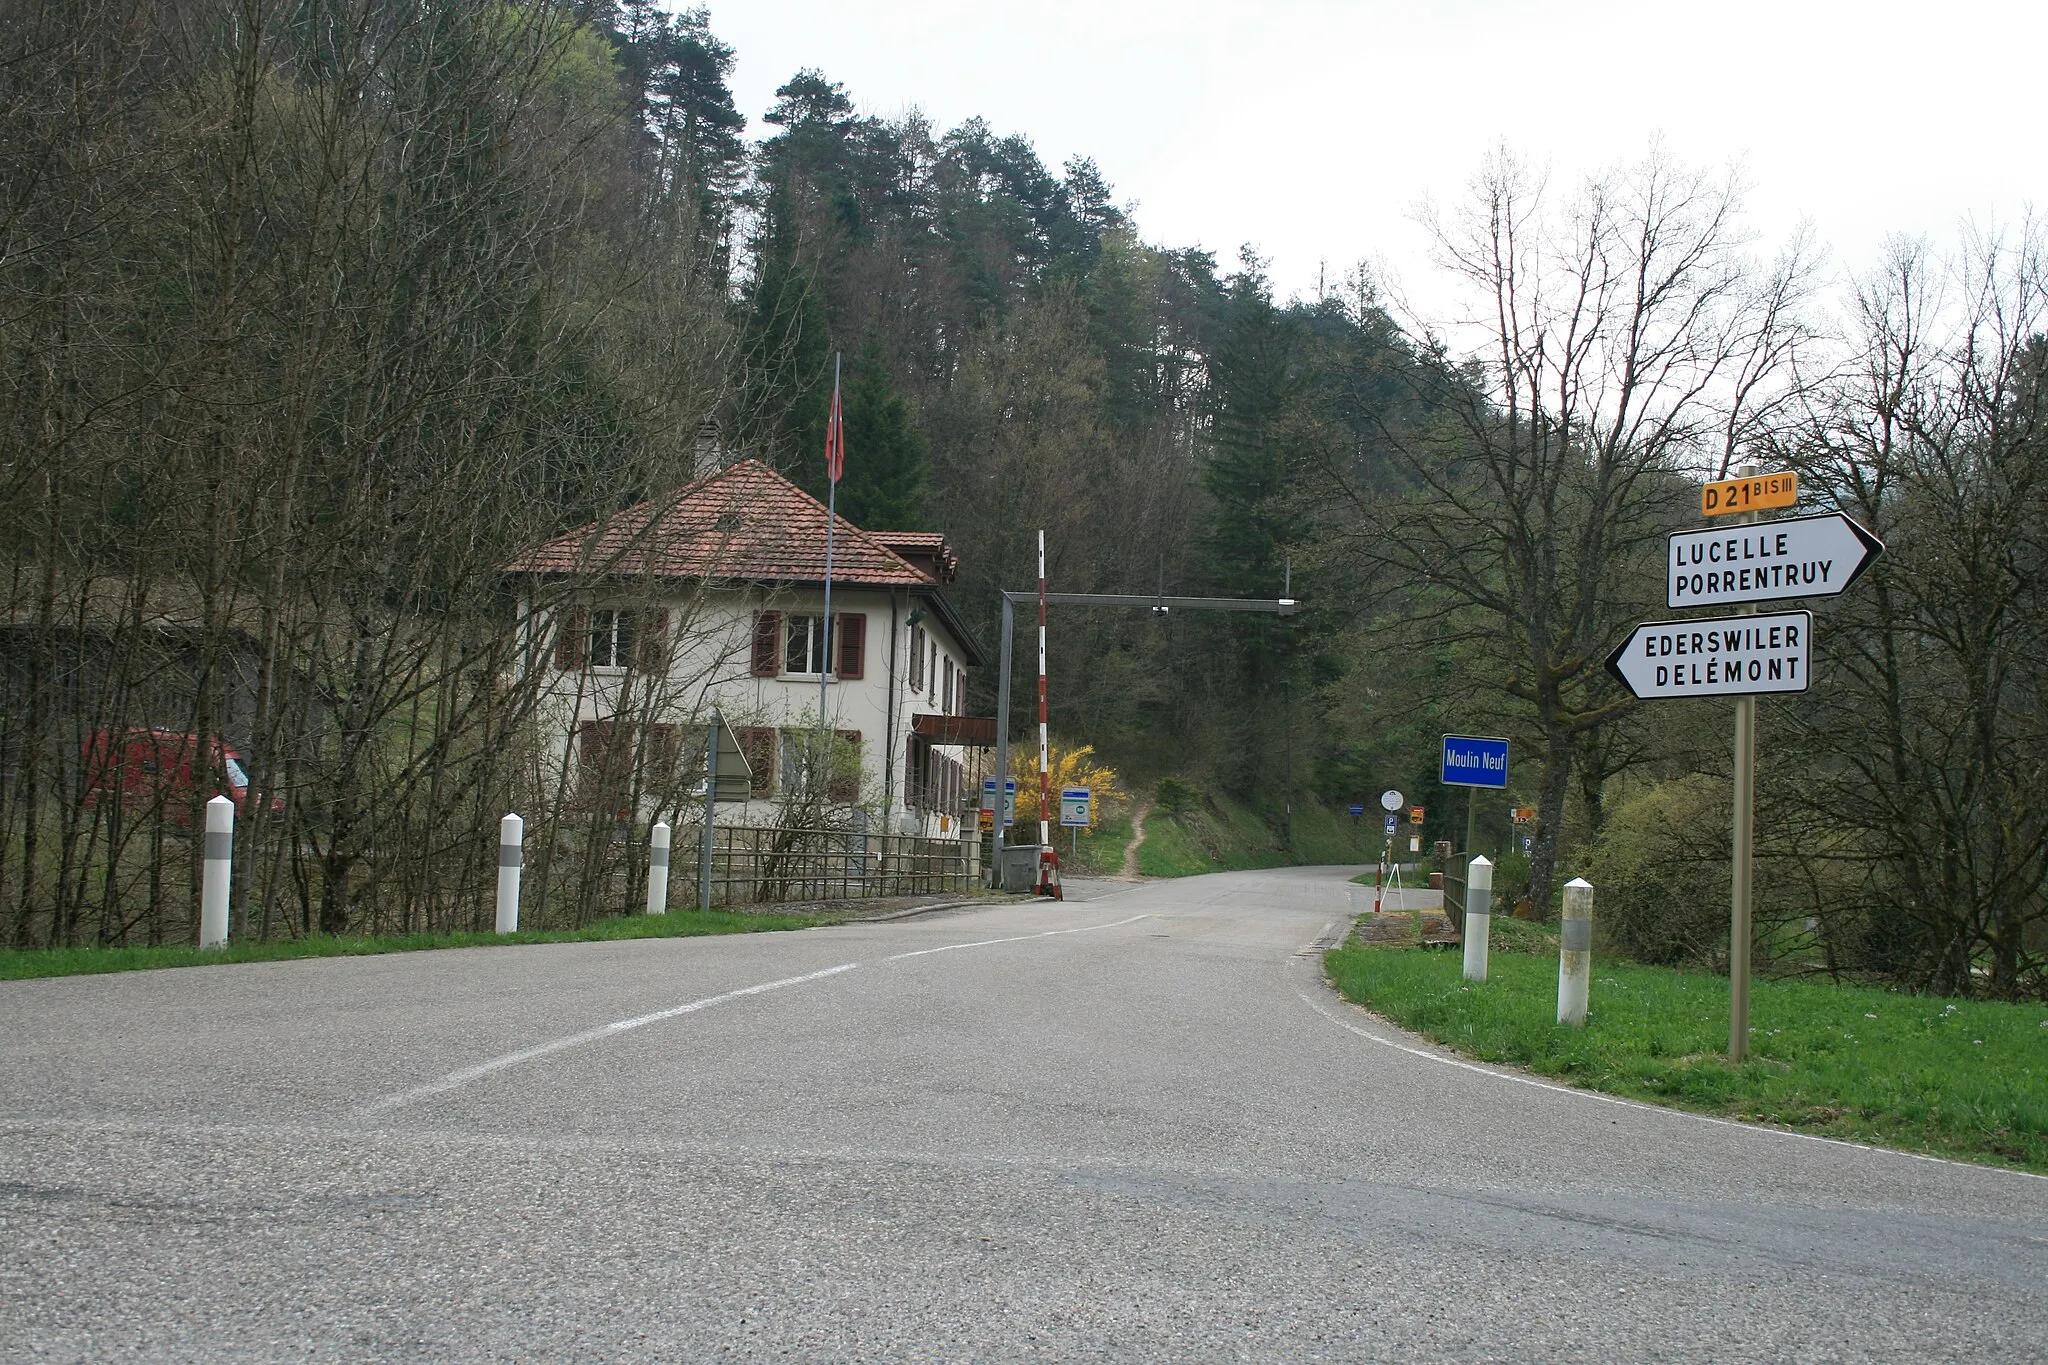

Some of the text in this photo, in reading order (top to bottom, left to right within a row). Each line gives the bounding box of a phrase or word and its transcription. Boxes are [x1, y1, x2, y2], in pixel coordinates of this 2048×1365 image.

[1706, 488, 1718, 510] D
[1676, 533, 1788, 567] LUCELLE
[1676, 560, 1832, 597] PORRENTRUY
[1645, 625, 1799, 657] EDERSWILER
[1656, 657, 1799, 687] DELÉMONT
[1446, 748, 1506, 771] Moulin Neuf
